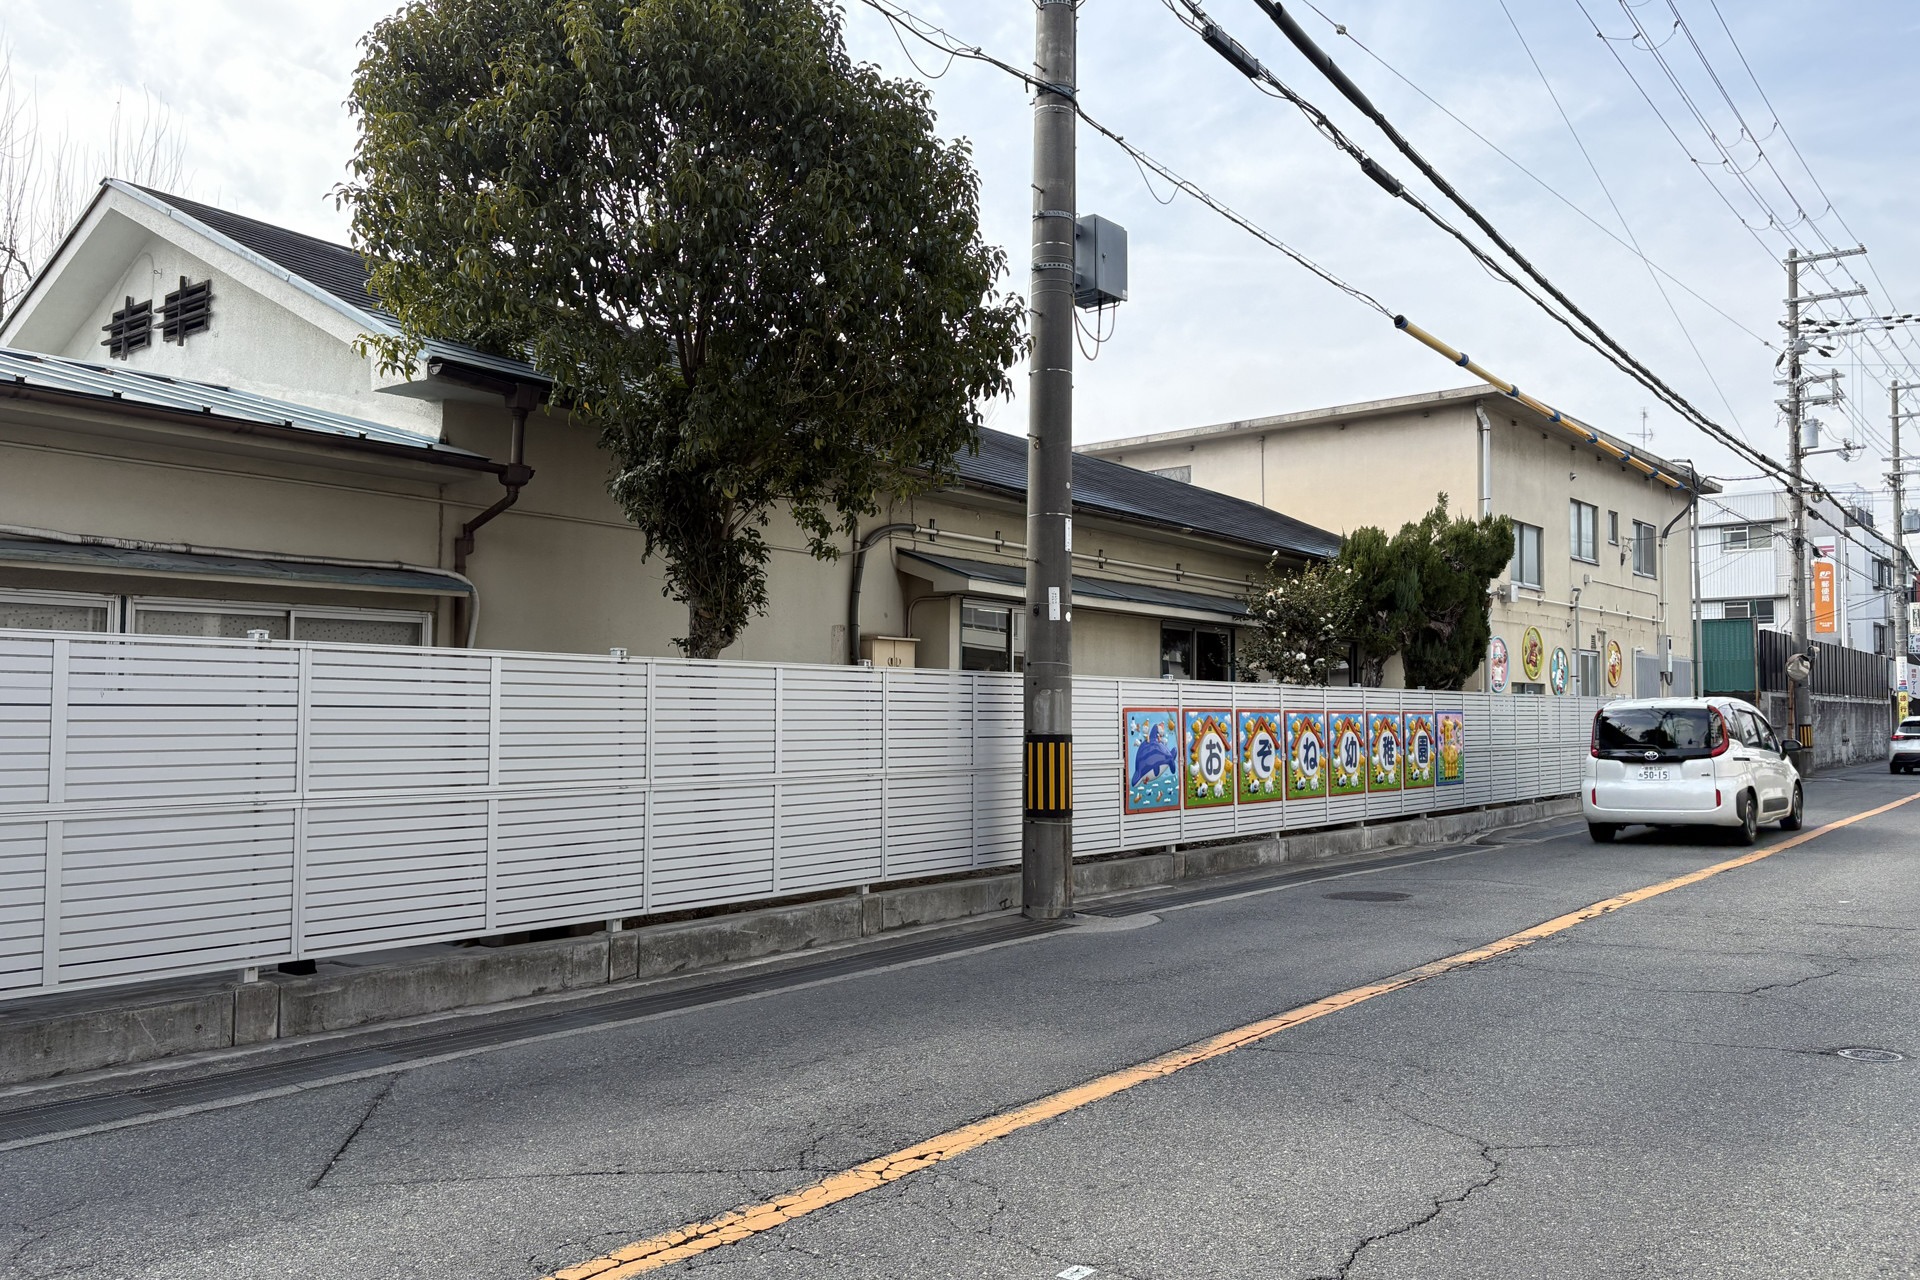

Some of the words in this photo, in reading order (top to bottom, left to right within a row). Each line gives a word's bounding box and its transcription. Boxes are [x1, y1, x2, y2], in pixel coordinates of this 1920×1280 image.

[1821, 581, 1830, 602] 郵便局
[1205, 735, 1429, 775] おぞね幼稚園
